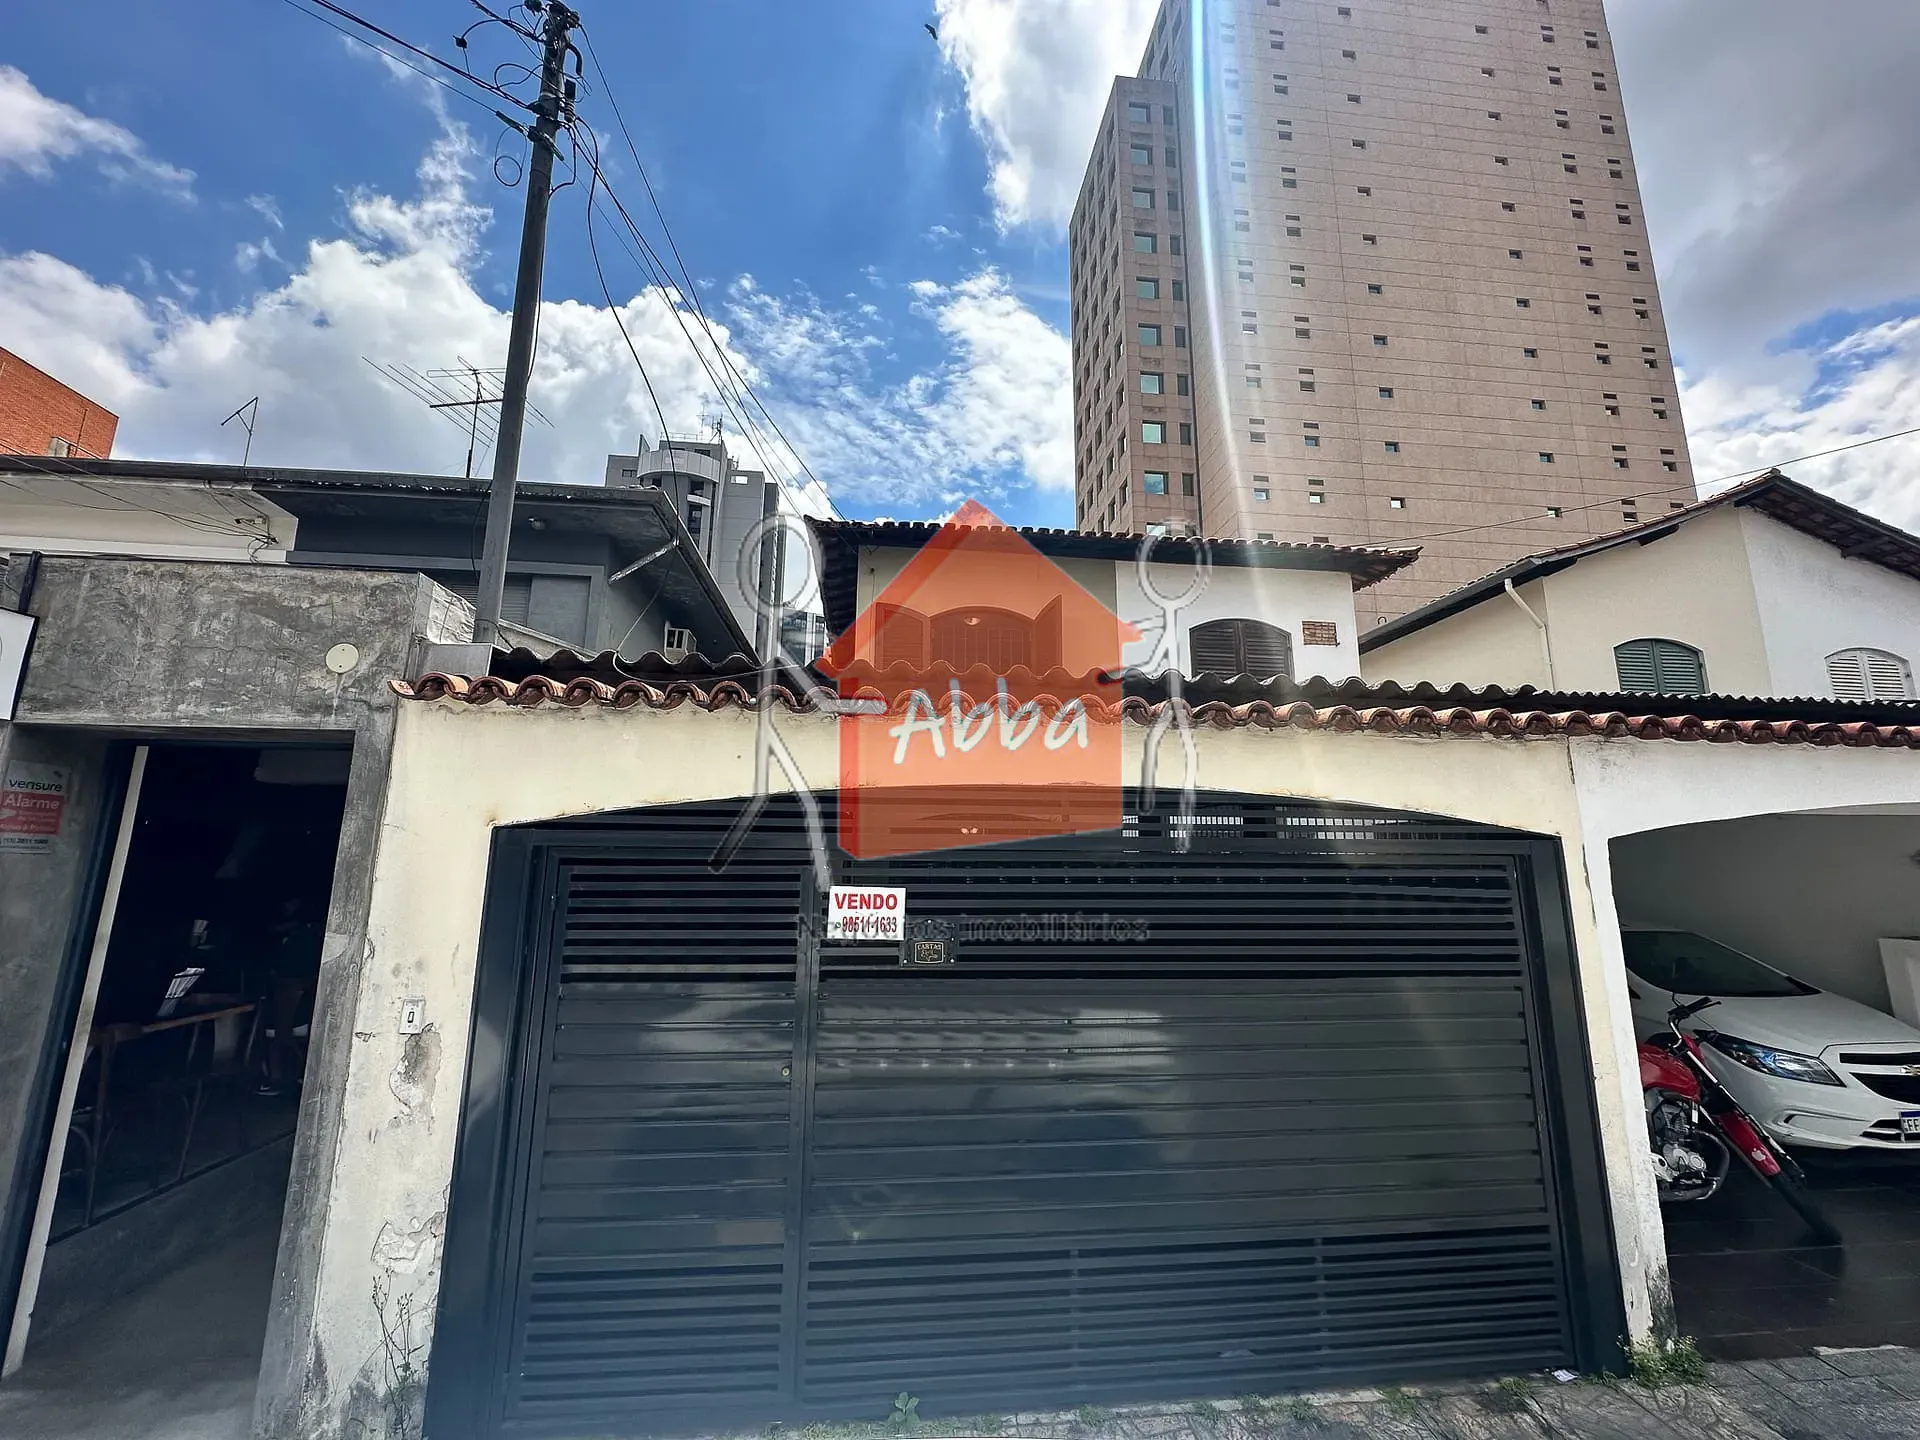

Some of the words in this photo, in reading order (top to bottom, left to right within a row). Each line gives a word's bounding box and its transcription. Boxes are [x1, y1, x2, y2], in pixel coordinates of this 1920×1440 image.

[3, 793, 60, 809] Alarme
[834, 893, 898, 910] VENDO
[842, 916, 897, 933] 98511-1633
